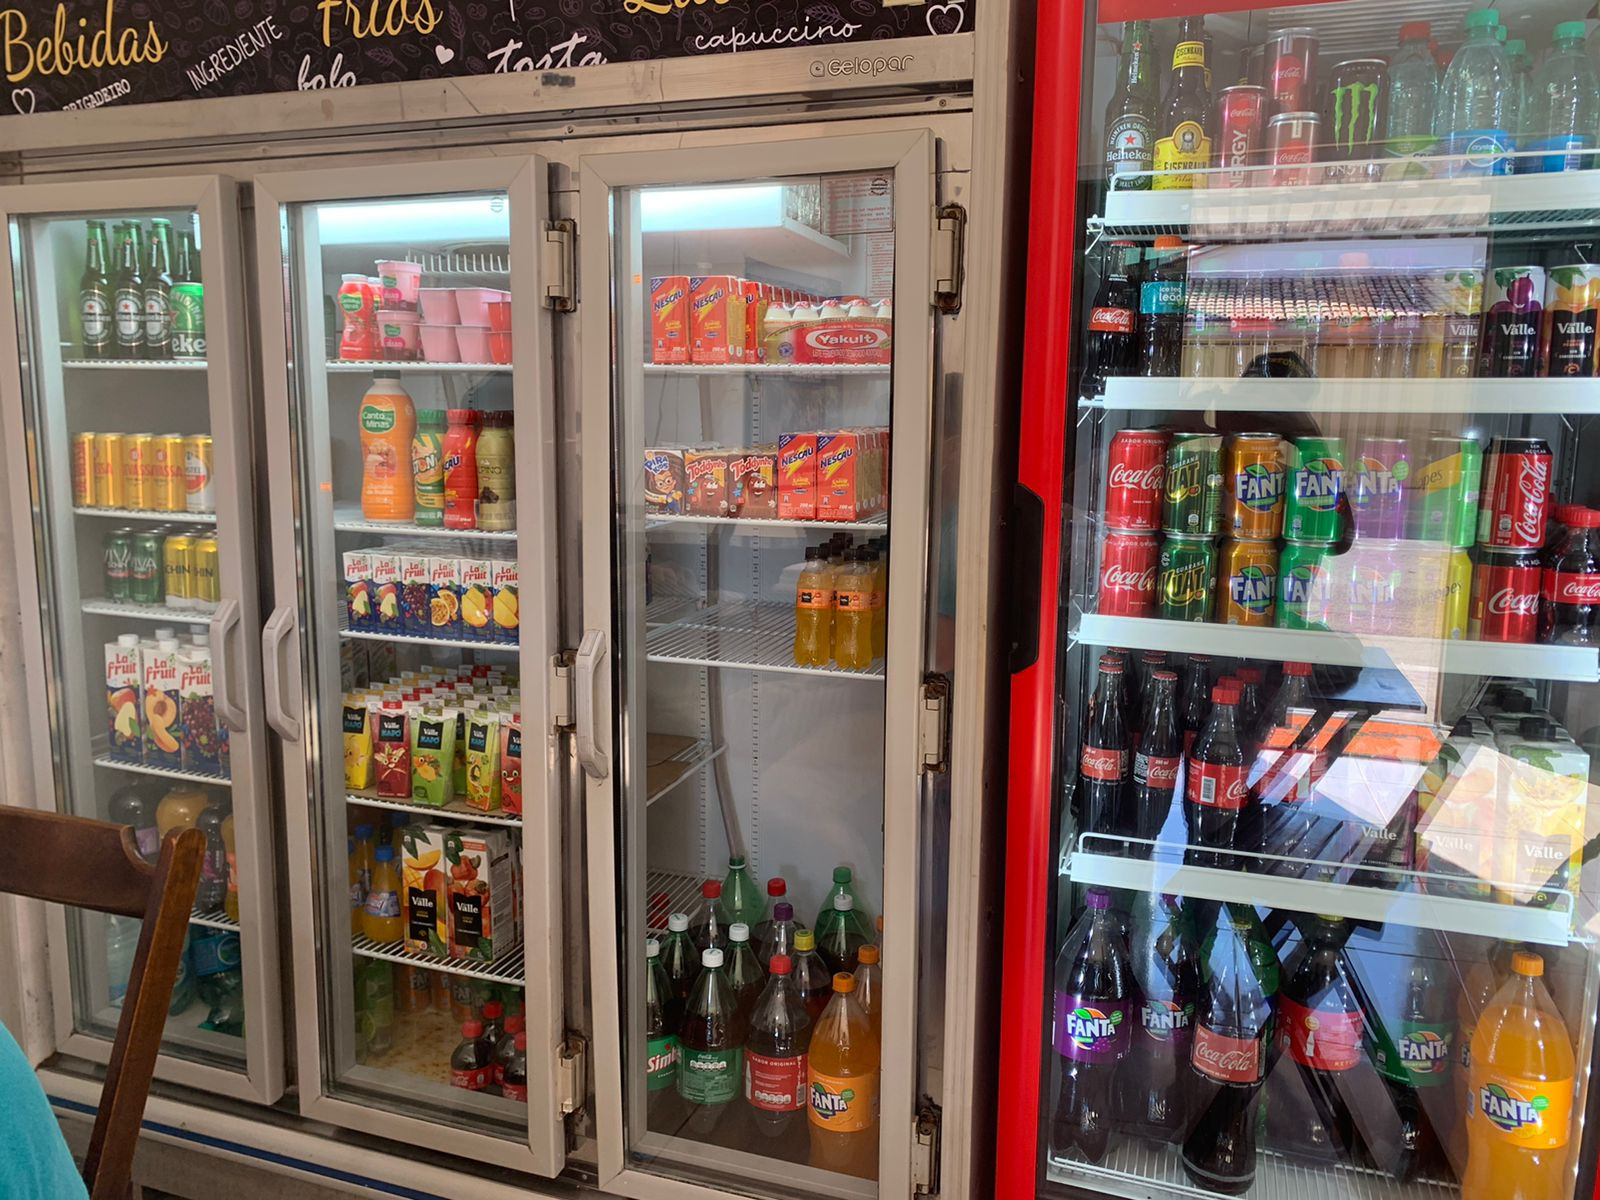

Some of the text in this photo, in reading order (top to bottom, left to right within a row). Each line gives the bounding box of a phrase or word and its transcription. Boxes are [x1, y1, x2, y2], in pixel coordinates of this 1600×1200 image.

[695, 15, 862, 53] capuccino
[0, 3, 168, 82] Bebidas
[187, 15, 283, 91] INGREDIENTE
[1106, 149, 1152, 161] Heineken
[654, 289, 684, 310] NESCAU
[693, 288, 724, 310] NESCAU
[1092, 308, 1130, 325] Coca-Cola
[1501, 324, 1535, 336] Valle
[1557, 322, 1594, 334] Valle
[818, 333, 874, 345] Yakult
[645, 456, 668, 471] PIRA
[781, 447, 813, 467] NESCAU
[820, 448, 853, 468] NESCAU
[686, 459, 727, 481] Toddynho
[730, 456, 774, 481] Toddynho
[1515, 457, 1548, 544] Coca-Cola
[352, 559, 361, 567] La
[380, 560, 389, 568] La
[410, 562, 419, 570] La
[439, 563, 448, 571] La
[470, 565, 480, 573] La
[116, 654, 128, 664] La
[154, 658, 167, 669] La
[107, 663, 136, 679] fruit
[146, 667, 177, 684] fruit
[189, 664, 203, 675] La
[181, 672, 211, 690] fruit
[1082, 754, 1114, 771] Coca-Cola
[1362, 826, 1398, 841] Valle
[1436, 835, 1473, 850] Valle
[1524, 844, 1564, 860] Valle
[411, 896, 434, 908] Valle
[456, 901, 479, 914] Valle
[1066, 1013, 1116, 1037] FANTA
[1141, 1007, 1188, 1029] FANTA
[1195, 1041, 1253, 1072] Coca-Cola
[1398, 1039, 1448, 1061] FANTA
[752, 1056, 768, 1066] SABOR
[810, 1085, 848, 1110] FANTA
[1480, 1087, 1539, 1122] FANTA
